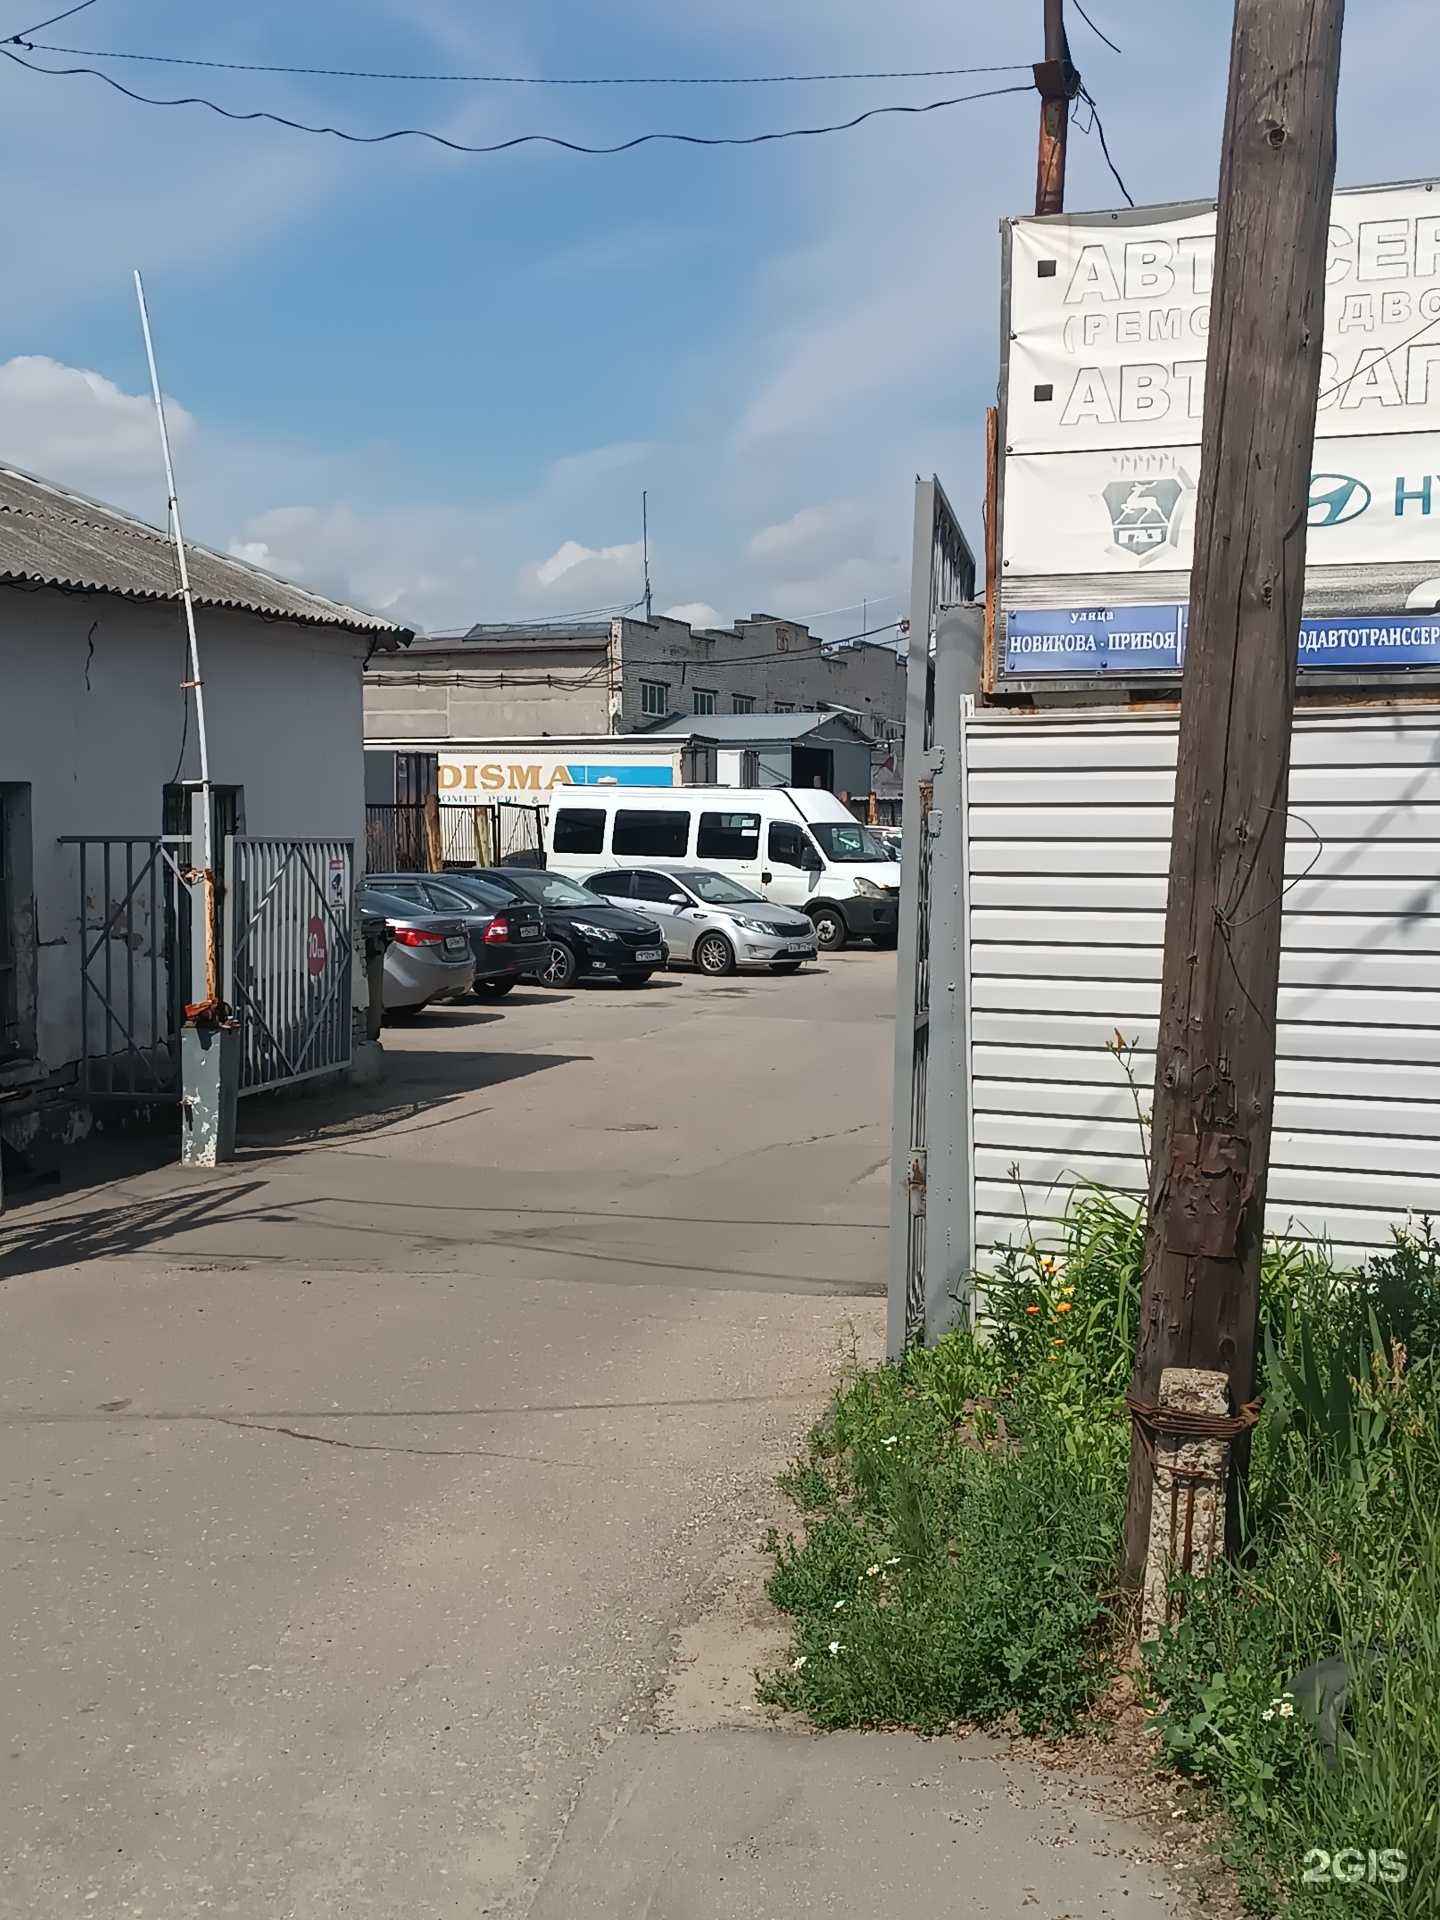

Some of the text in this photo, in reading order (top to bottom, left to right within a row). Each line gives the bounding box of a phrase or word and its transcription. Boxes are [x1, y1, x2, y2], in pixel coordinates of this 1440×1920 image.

[1009, 634, 1097, 653] НОВИКОВА
[1107, 631, 1177, 650] ПРИБОЯ
[438, 764, 573, 789] DISMA
